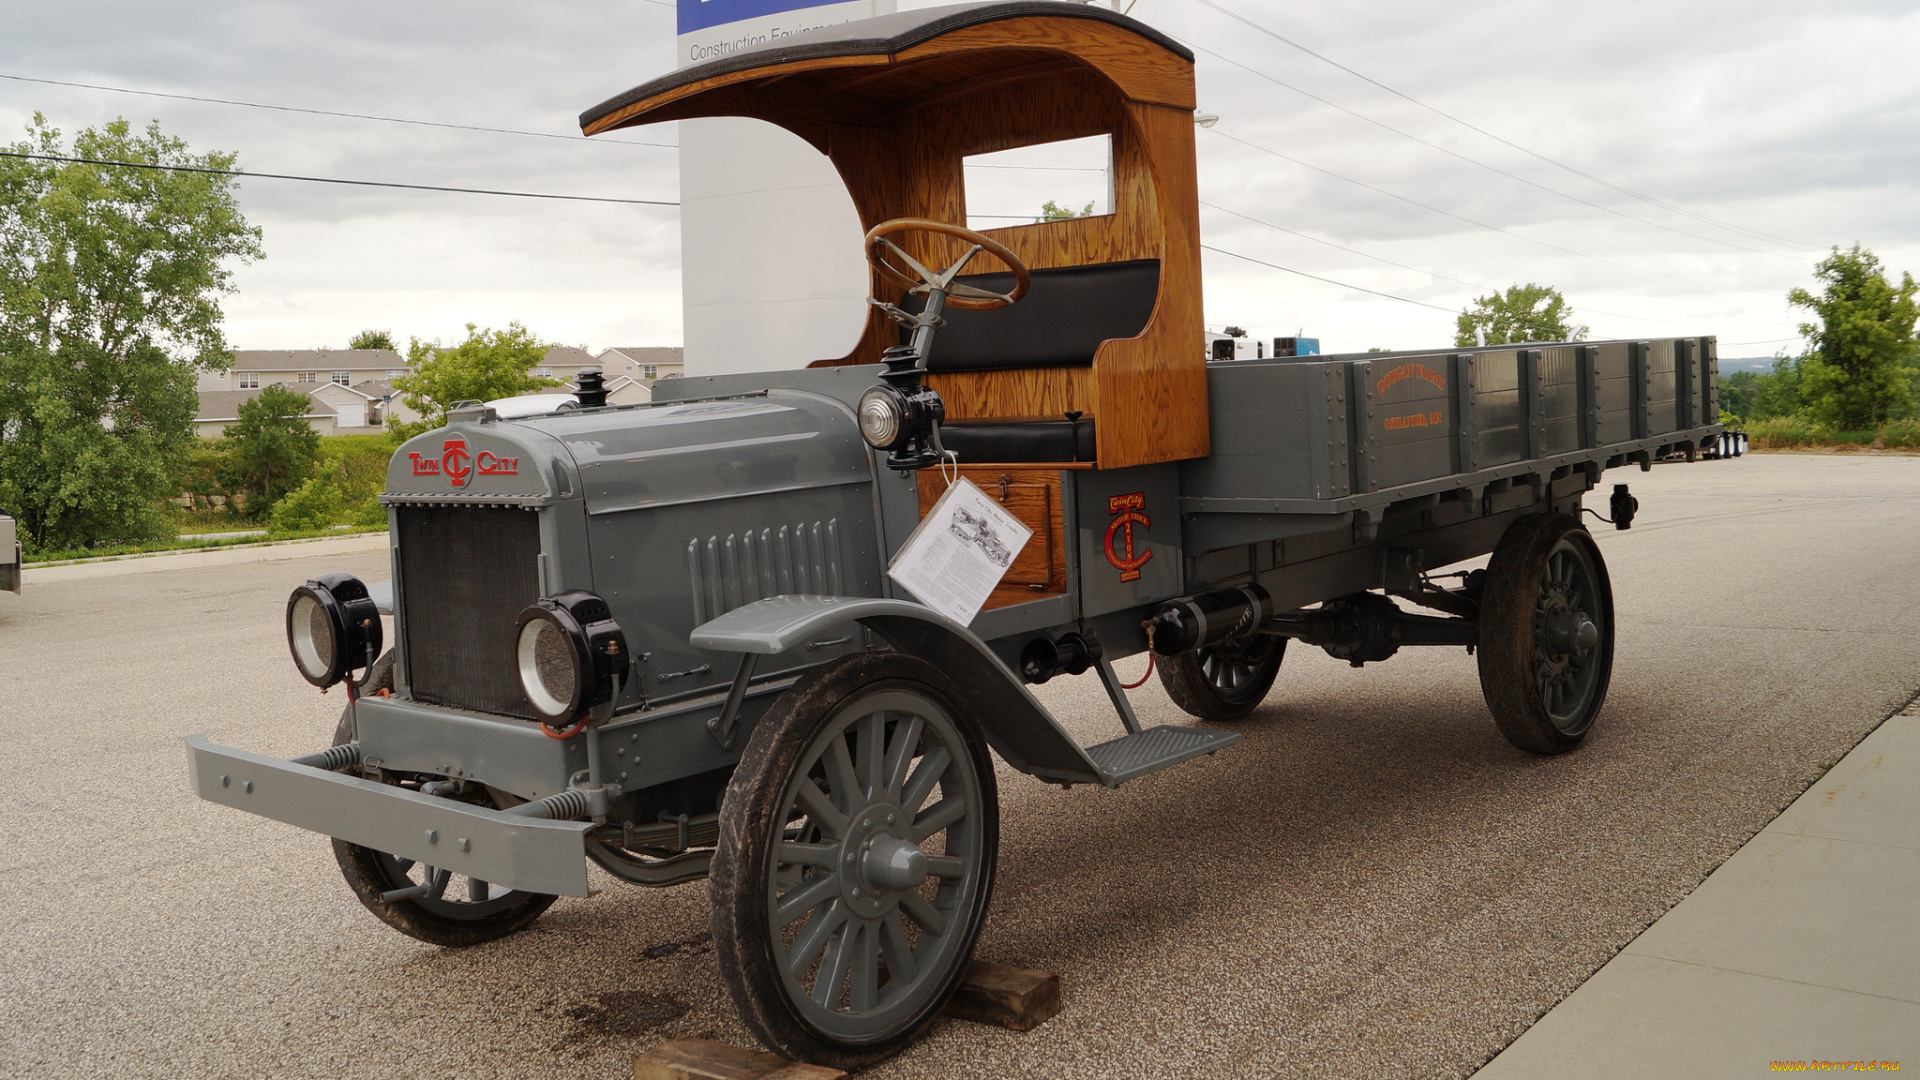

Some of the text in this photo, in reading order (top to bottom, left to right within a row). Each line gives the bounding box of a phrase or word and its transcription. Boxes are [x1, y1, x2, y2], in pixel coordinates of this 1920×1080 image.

[690, 33, 766, 61] Construction
[1376, 363, 1446, 396] DOUGAN FARMS
